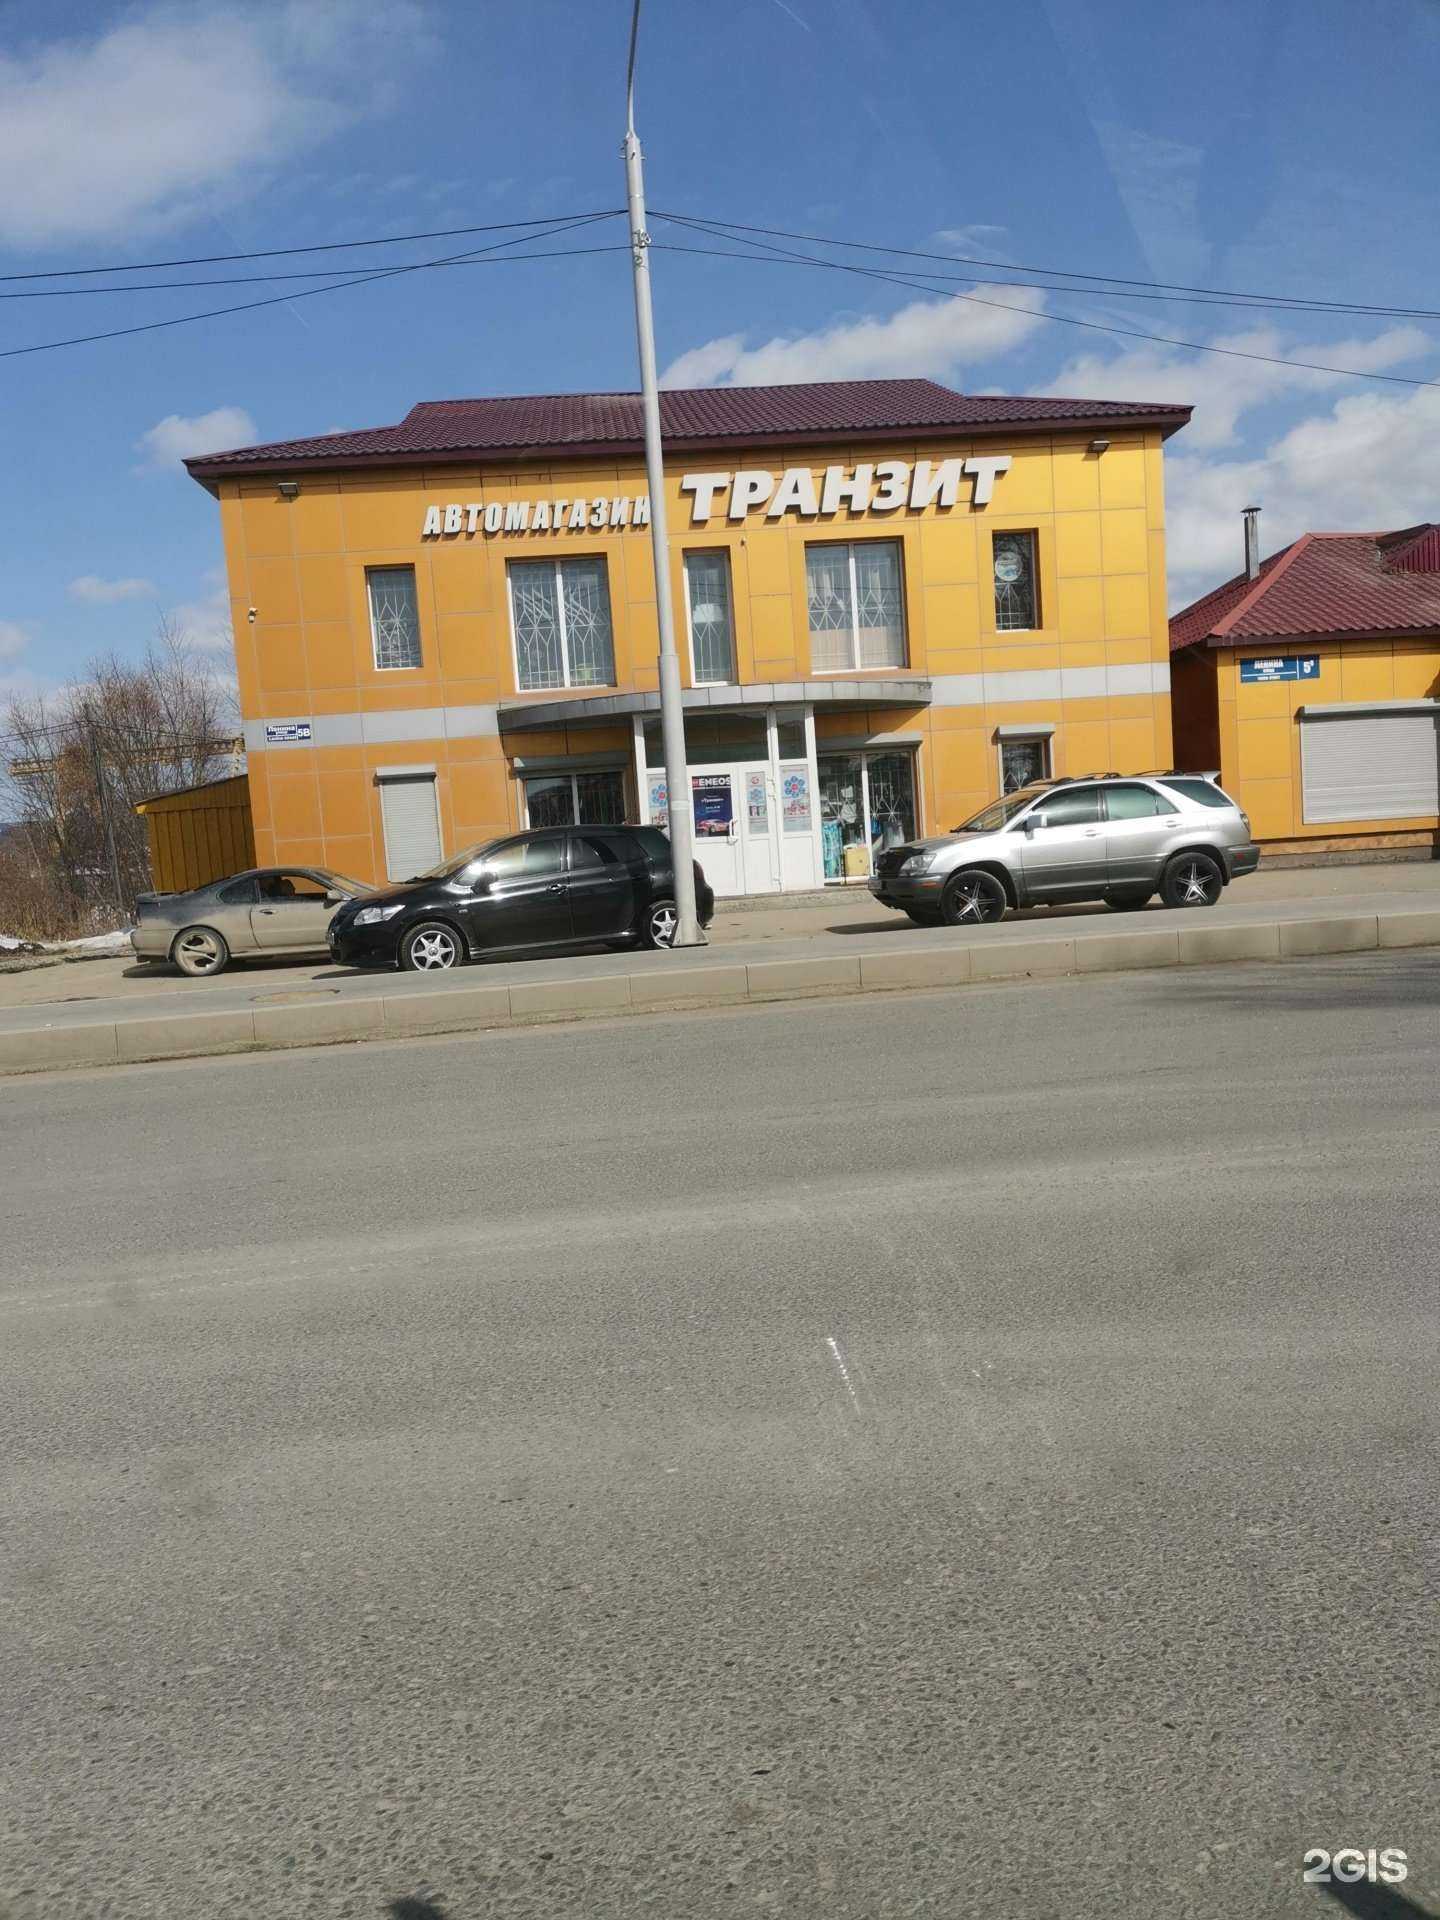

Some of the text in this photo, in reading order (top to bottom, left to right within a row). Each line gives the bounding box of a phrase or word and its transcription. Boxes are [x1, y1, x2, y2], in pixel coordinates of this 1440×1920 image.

[422, 456, 1012, 535] АВТОМАГАЗИН ТРАНЗИТ
[699, 777, 731, 787] ENEOS
